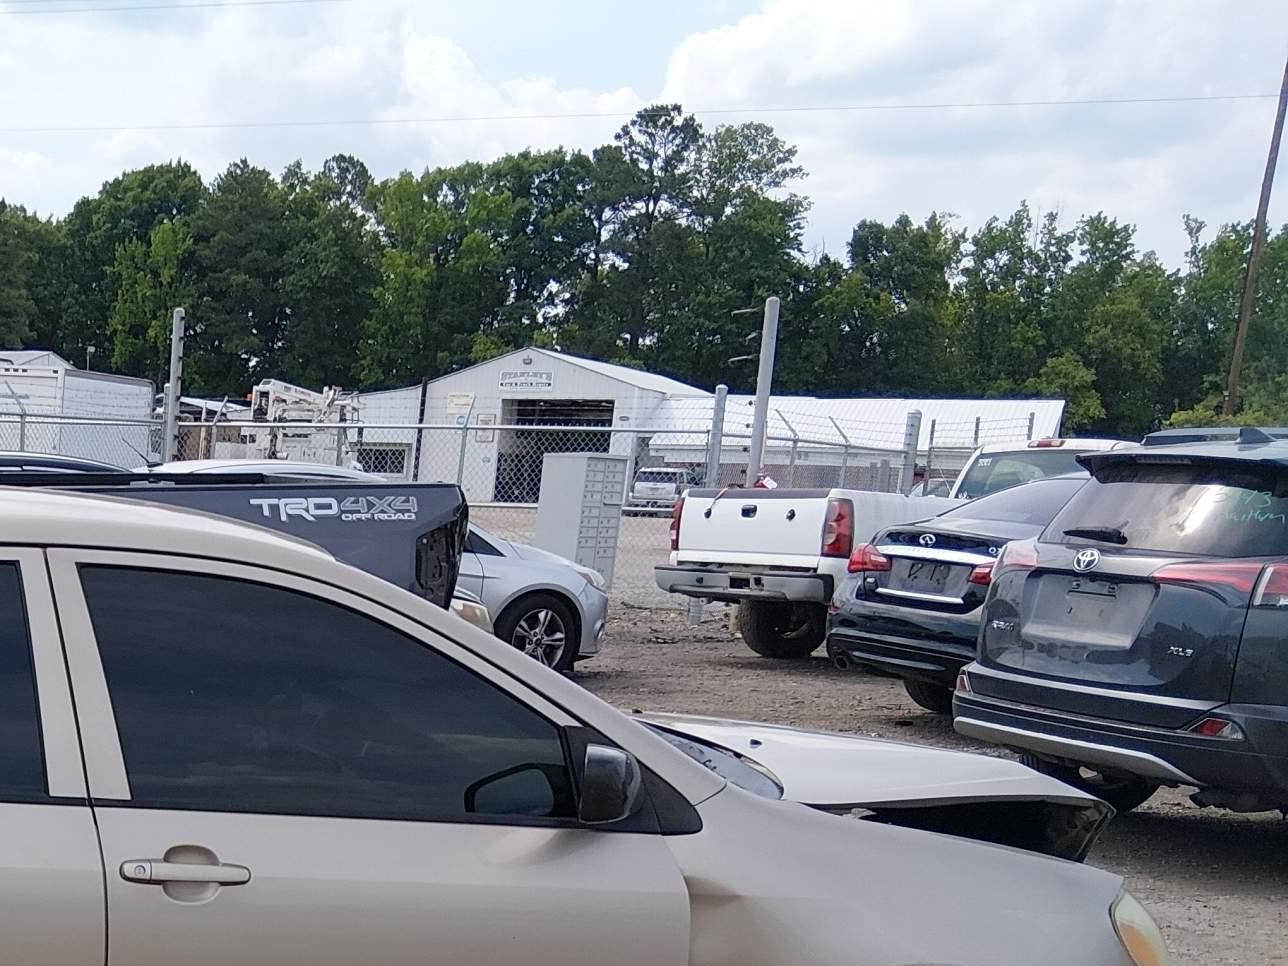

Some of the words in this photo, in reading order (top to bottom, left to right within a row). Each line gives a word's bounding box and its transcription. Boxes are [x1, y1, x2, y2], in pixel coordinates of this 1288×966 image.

[249, 497, 339, 522] TRD
[341, 513, 372, 521] OFF
[373, 512, 417, 521] ROAD
